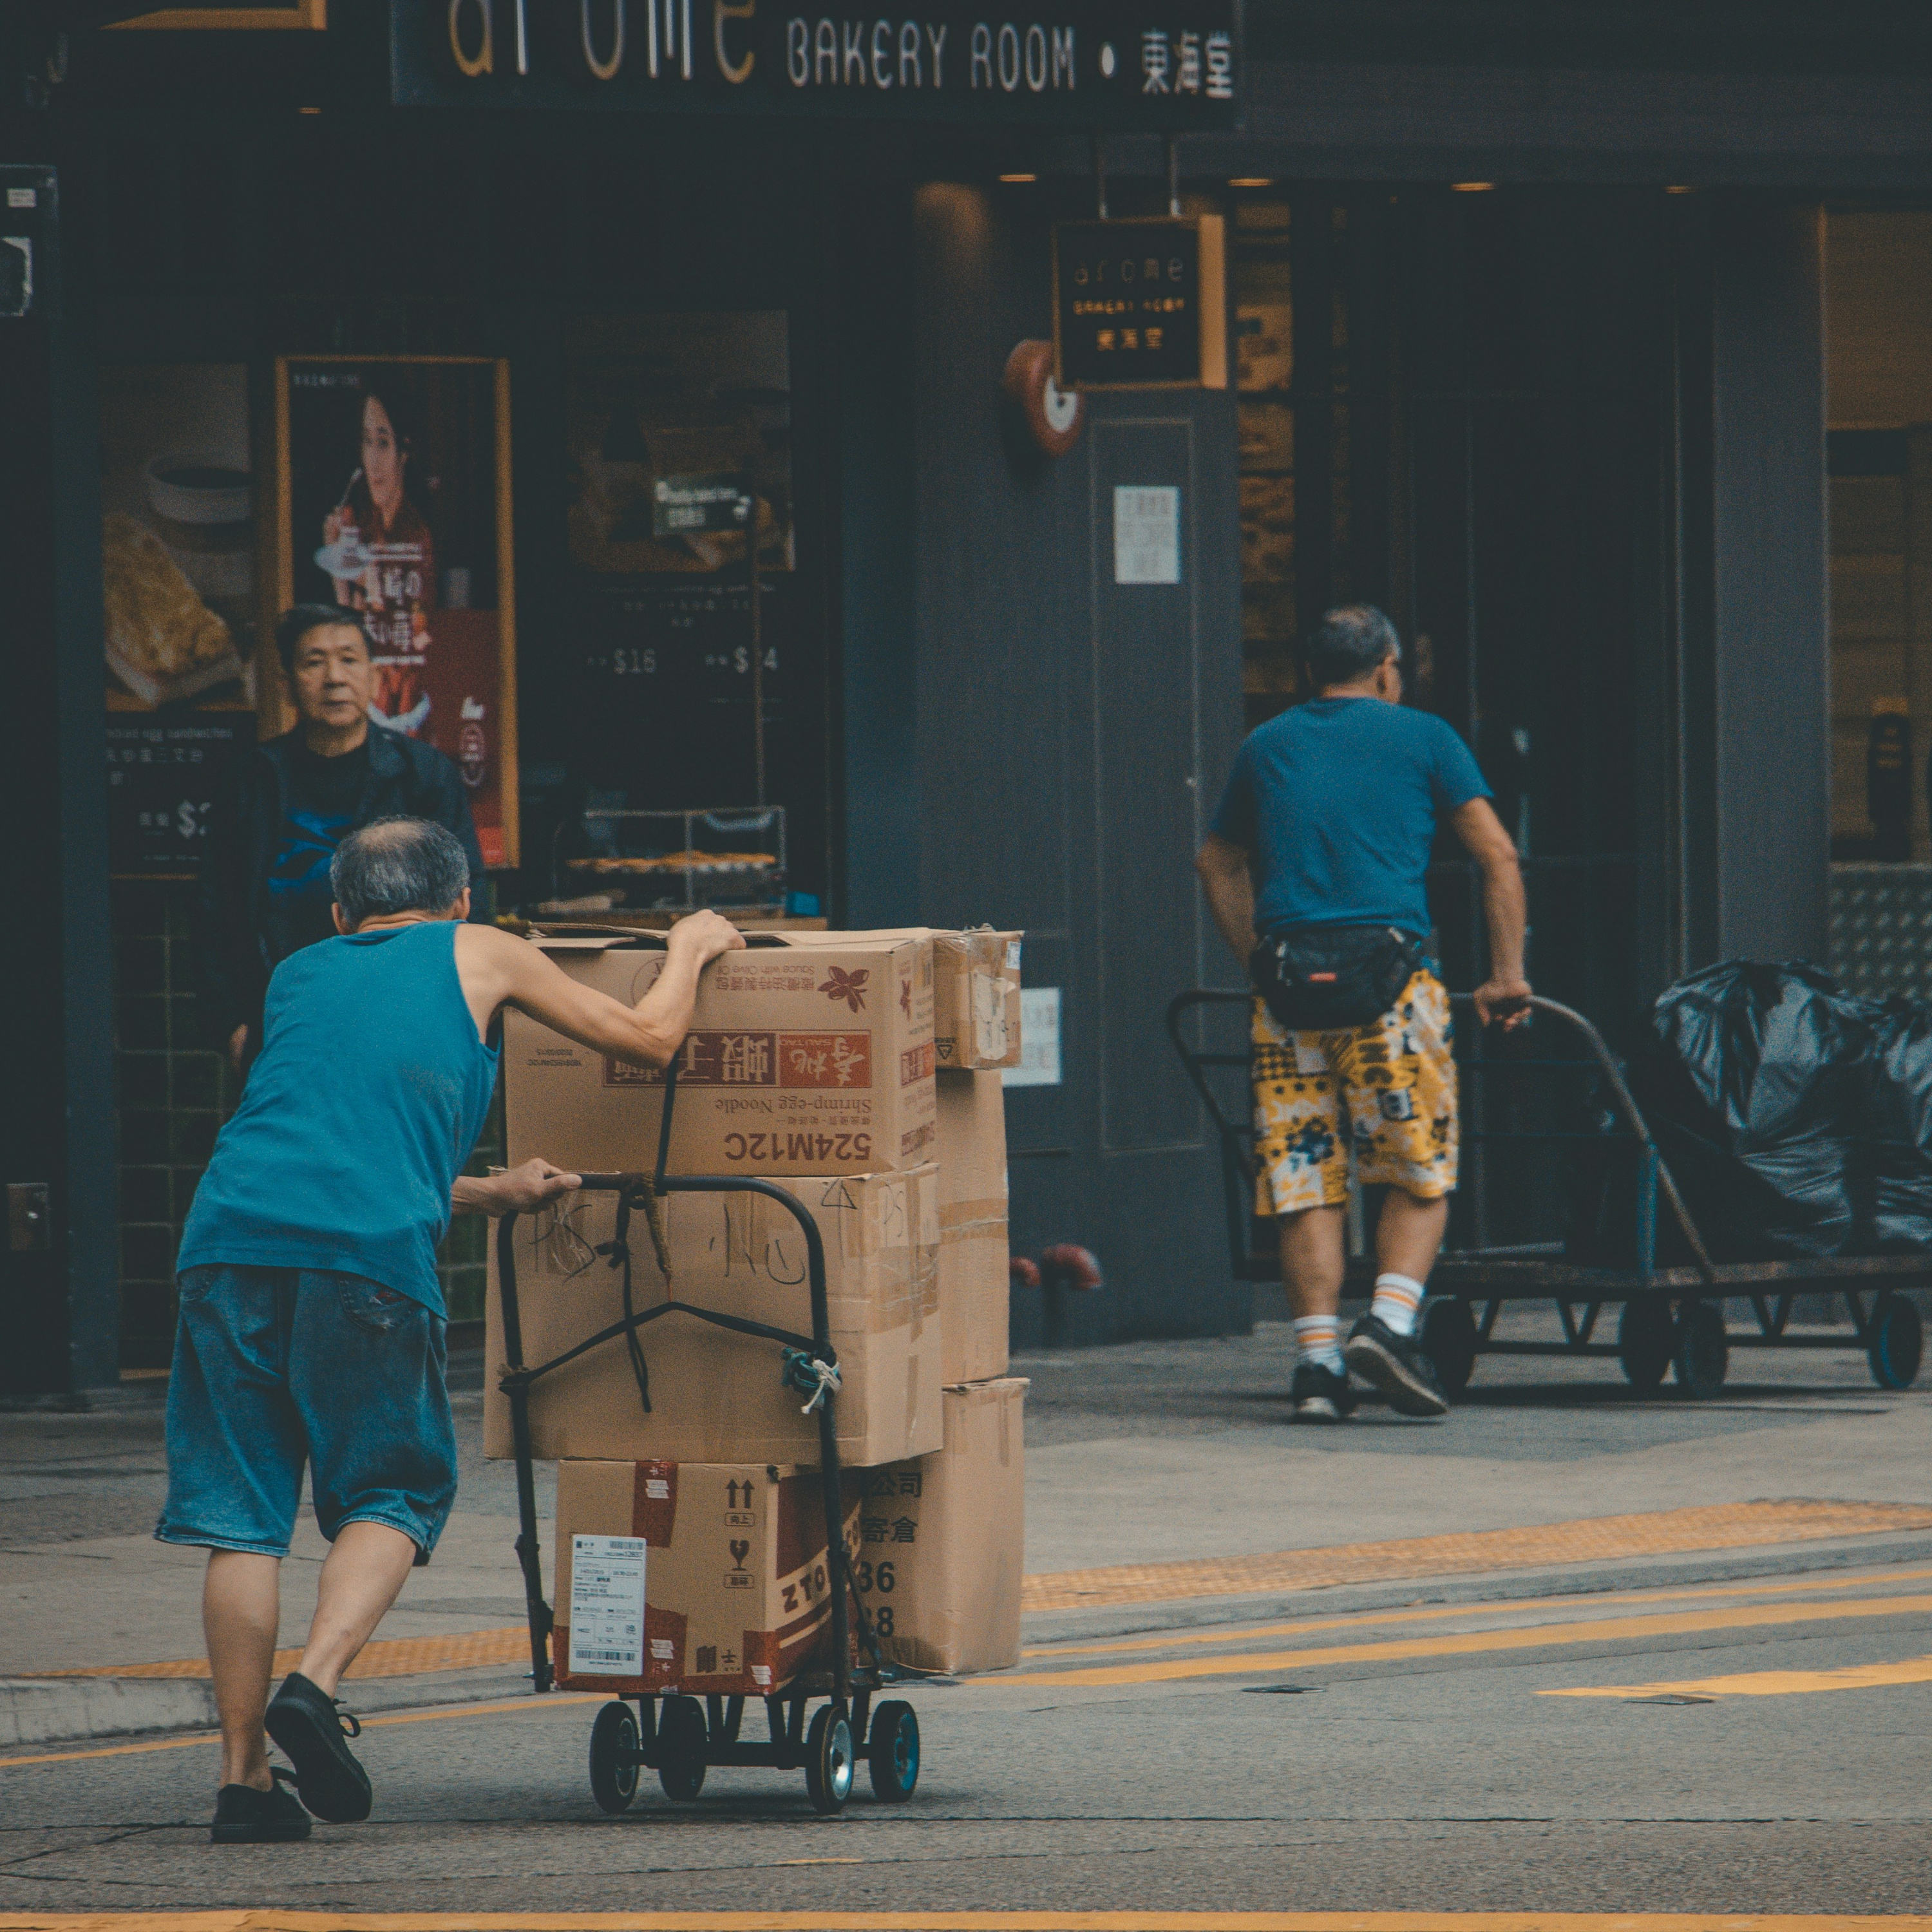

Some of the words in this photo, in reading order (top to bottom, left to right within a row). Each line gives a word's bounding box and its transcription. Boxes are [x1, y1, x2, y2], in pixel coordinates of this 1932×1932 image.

[786, 17, 948, 90] BAKERY
[970, 21, 1077, 93] ROOM
[613, 647, 658, 675] $16
[714, 1098, 773, 1113] Noodle
[778, 1095, 872, 1113] Shrimp-egg
[724, 1132, 871, 1161] 524M12C
[860, 1471, 922, 1498] 公司
[781, 1564, 827, 1613] ZTO
[866, 1606, 895, 1638] 8
